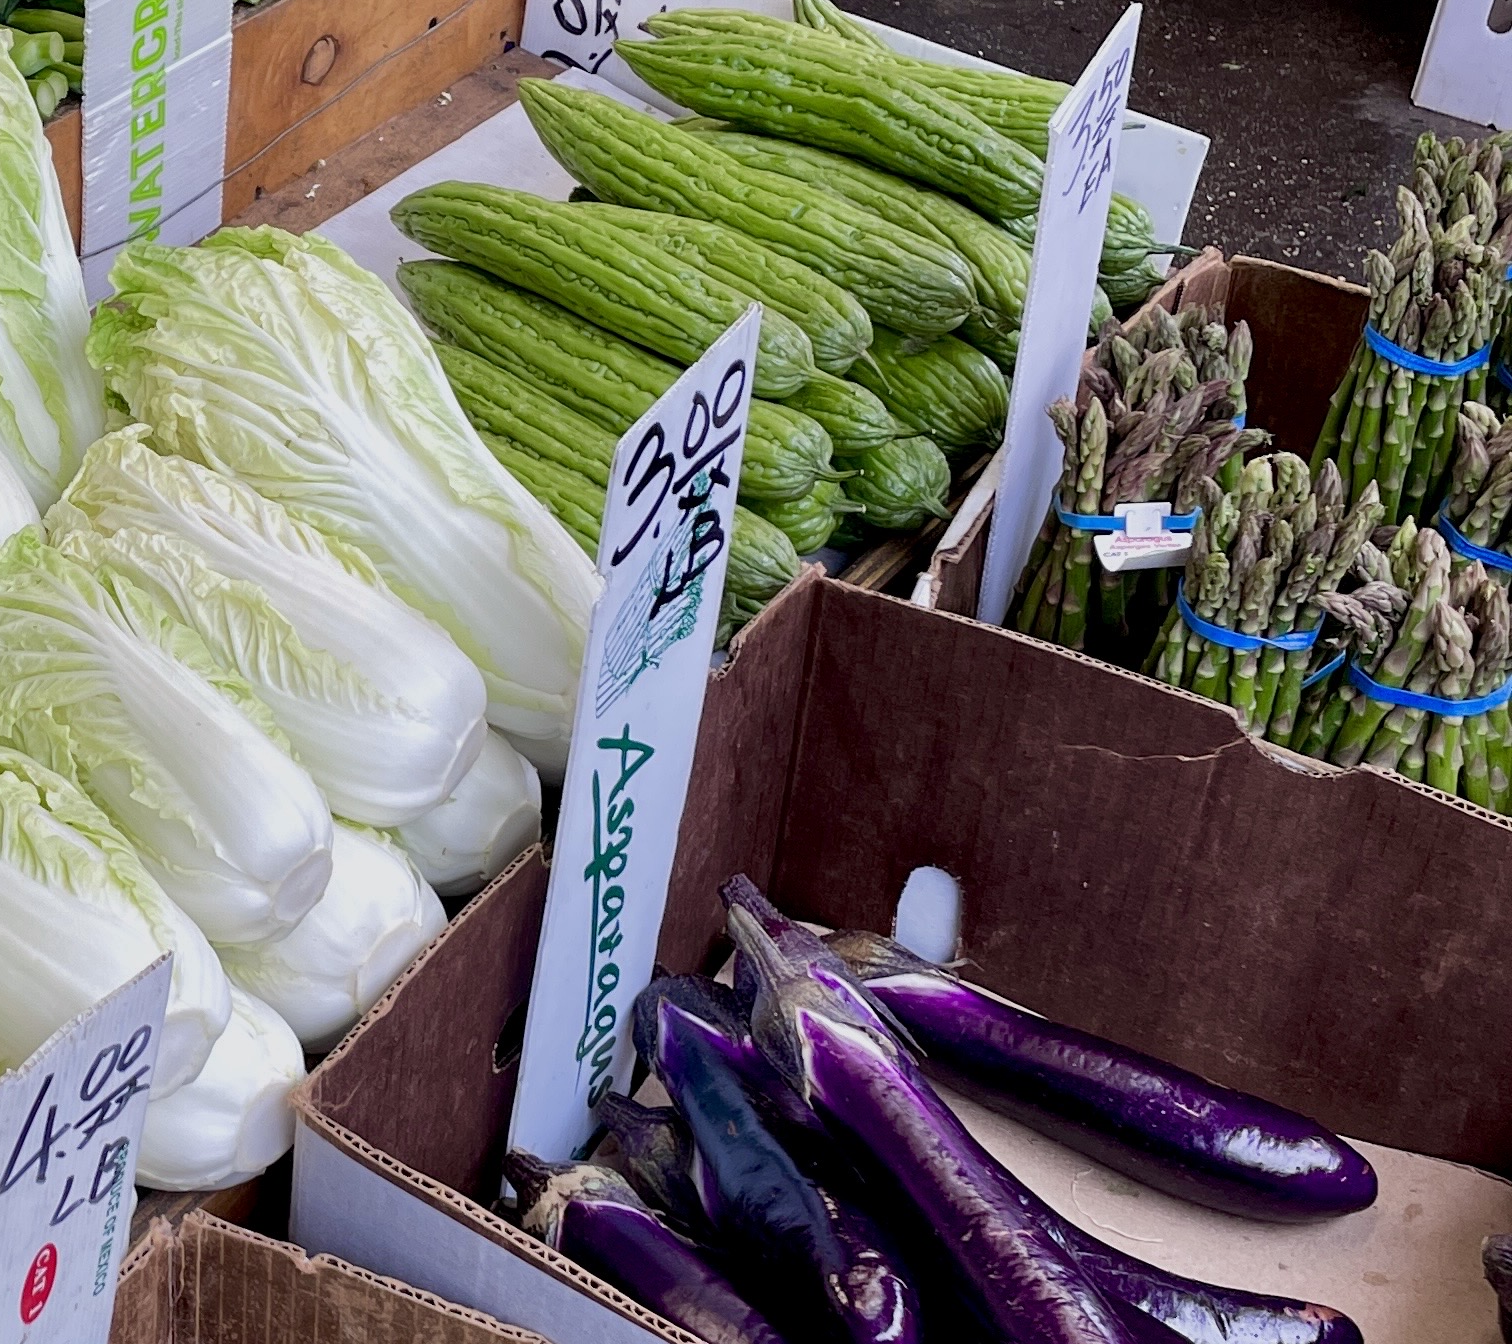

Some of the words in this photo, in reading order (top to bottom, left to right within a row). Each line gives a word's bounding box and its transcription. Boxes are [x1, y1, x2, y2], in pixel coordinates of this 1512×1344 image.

[1062, 47, 1130, 196] 3.50
[1078, 137, 1113, 215] EA
[611, 359, 745, 567] 3.00
[648, 509, 725, 622] LB
[1114, 535, 1174, 545] Asparagus
[574, 722, 656, 1109] Asparagus
[50, 1136, 130, 1227] LB
[92, 1238, 114, 1297] MEXICO
[102, 1215, 119, 1238] OF
[30, 1246, 50, 1296] CAT
